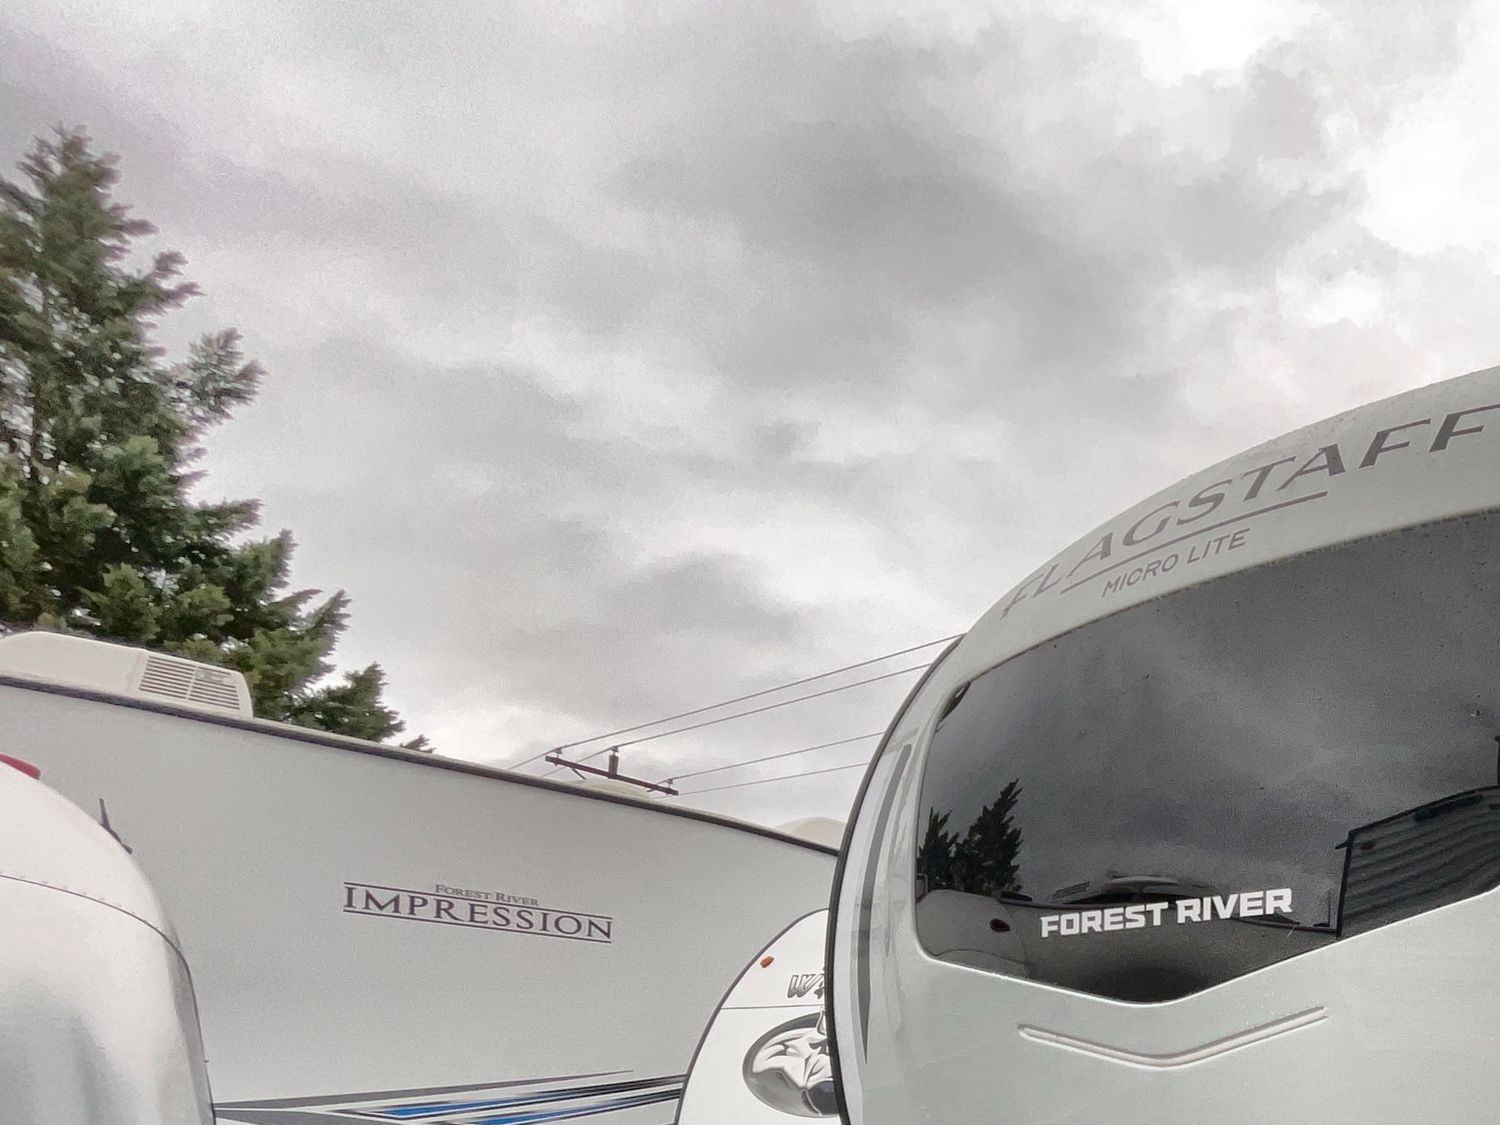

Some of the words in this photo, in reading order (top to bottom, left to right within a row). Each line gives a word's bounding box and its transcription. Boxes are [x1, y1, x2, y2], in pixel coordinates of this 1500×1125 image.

[1101, 553, 1178, 598] MICRO
[1187, 528, 1251, 565] LITE
[343, 886, 612, 940] IMPRESSION
[434, 883, 492, 900] FOREST
[495, 892, 540, 907] RIVER
[1040, 901, 1169, 938] FOREST
[1176, 887, 1293, 924] RIVER
